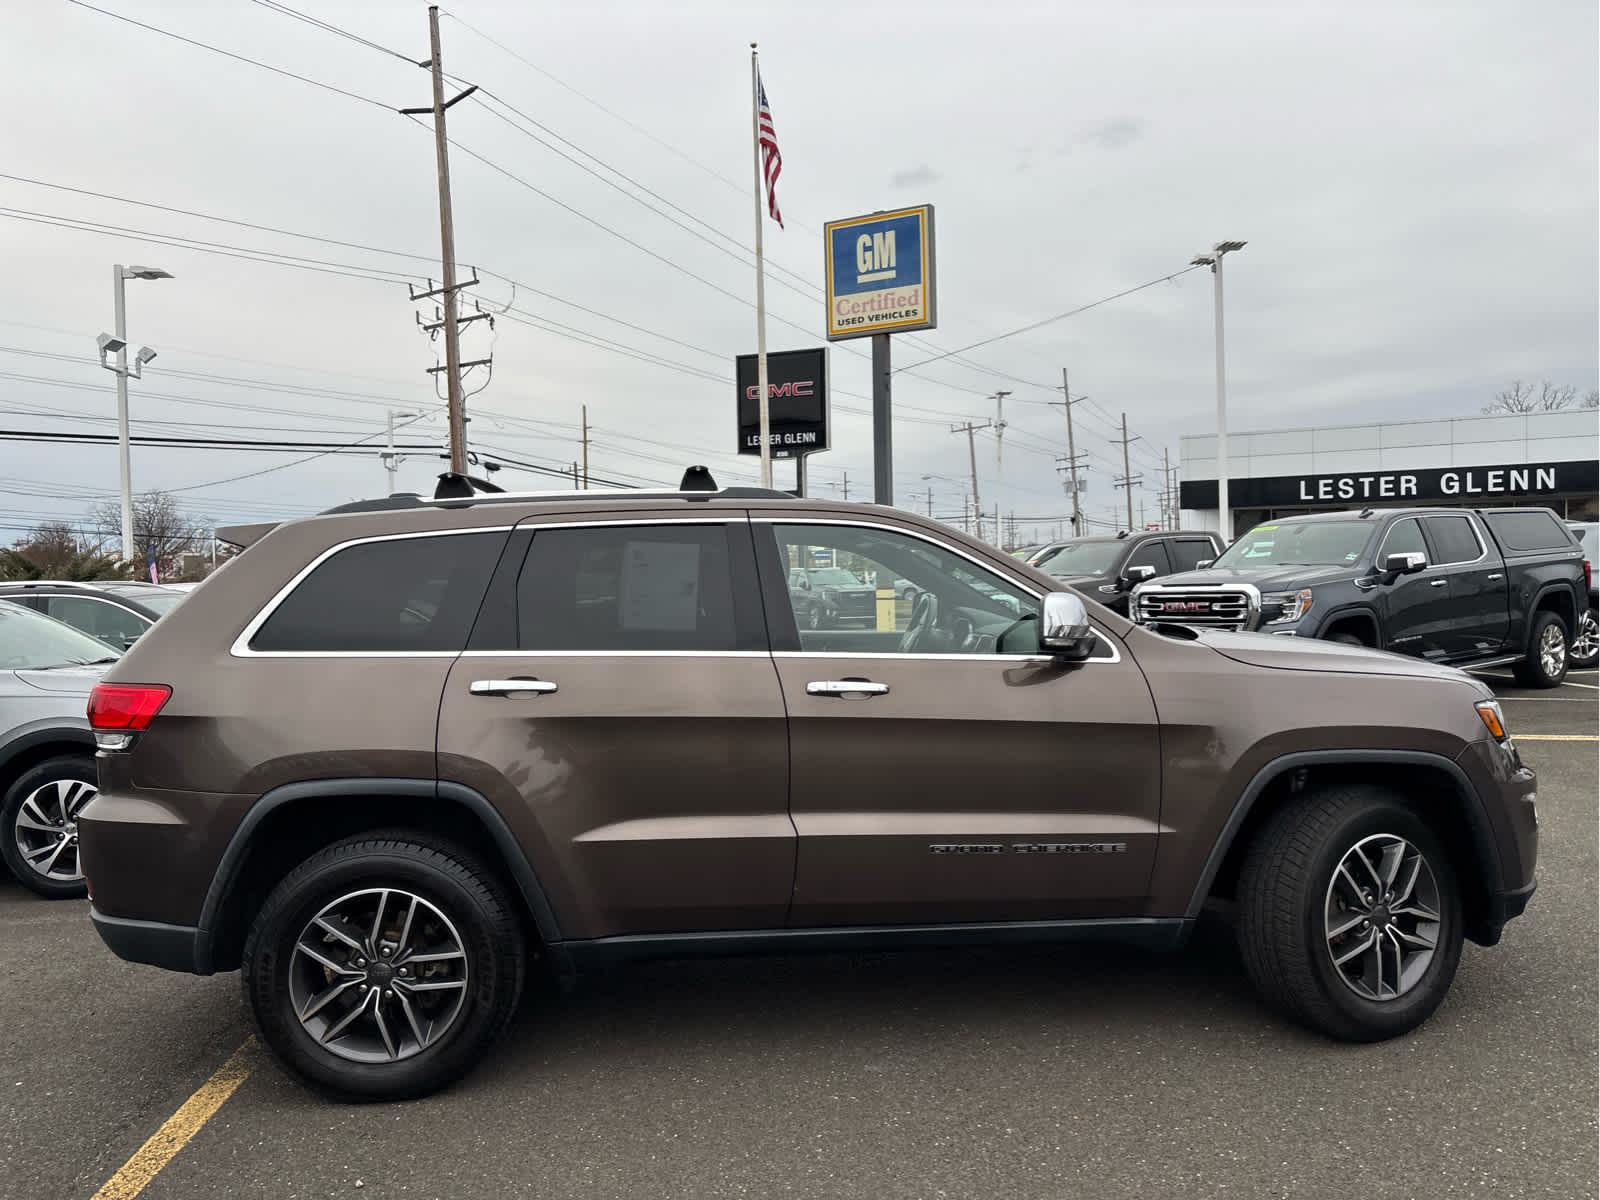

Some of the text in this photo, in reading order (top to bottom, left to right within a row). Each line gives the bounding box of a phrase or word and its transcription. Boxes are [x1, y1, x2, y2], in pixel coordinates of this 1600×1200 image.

[857, 230, 896, 273] GM
[836, 288, 919, 316] Certified
[838, 309, 918, 326] USED VEHICLES
[746, 381, 814, 400] GMC
[747, 432, 816, 446] LEER GLENN
[1300, 468, 1556, 500] LESTER GLENN
[1164, 602, 1210, 613] GMC
